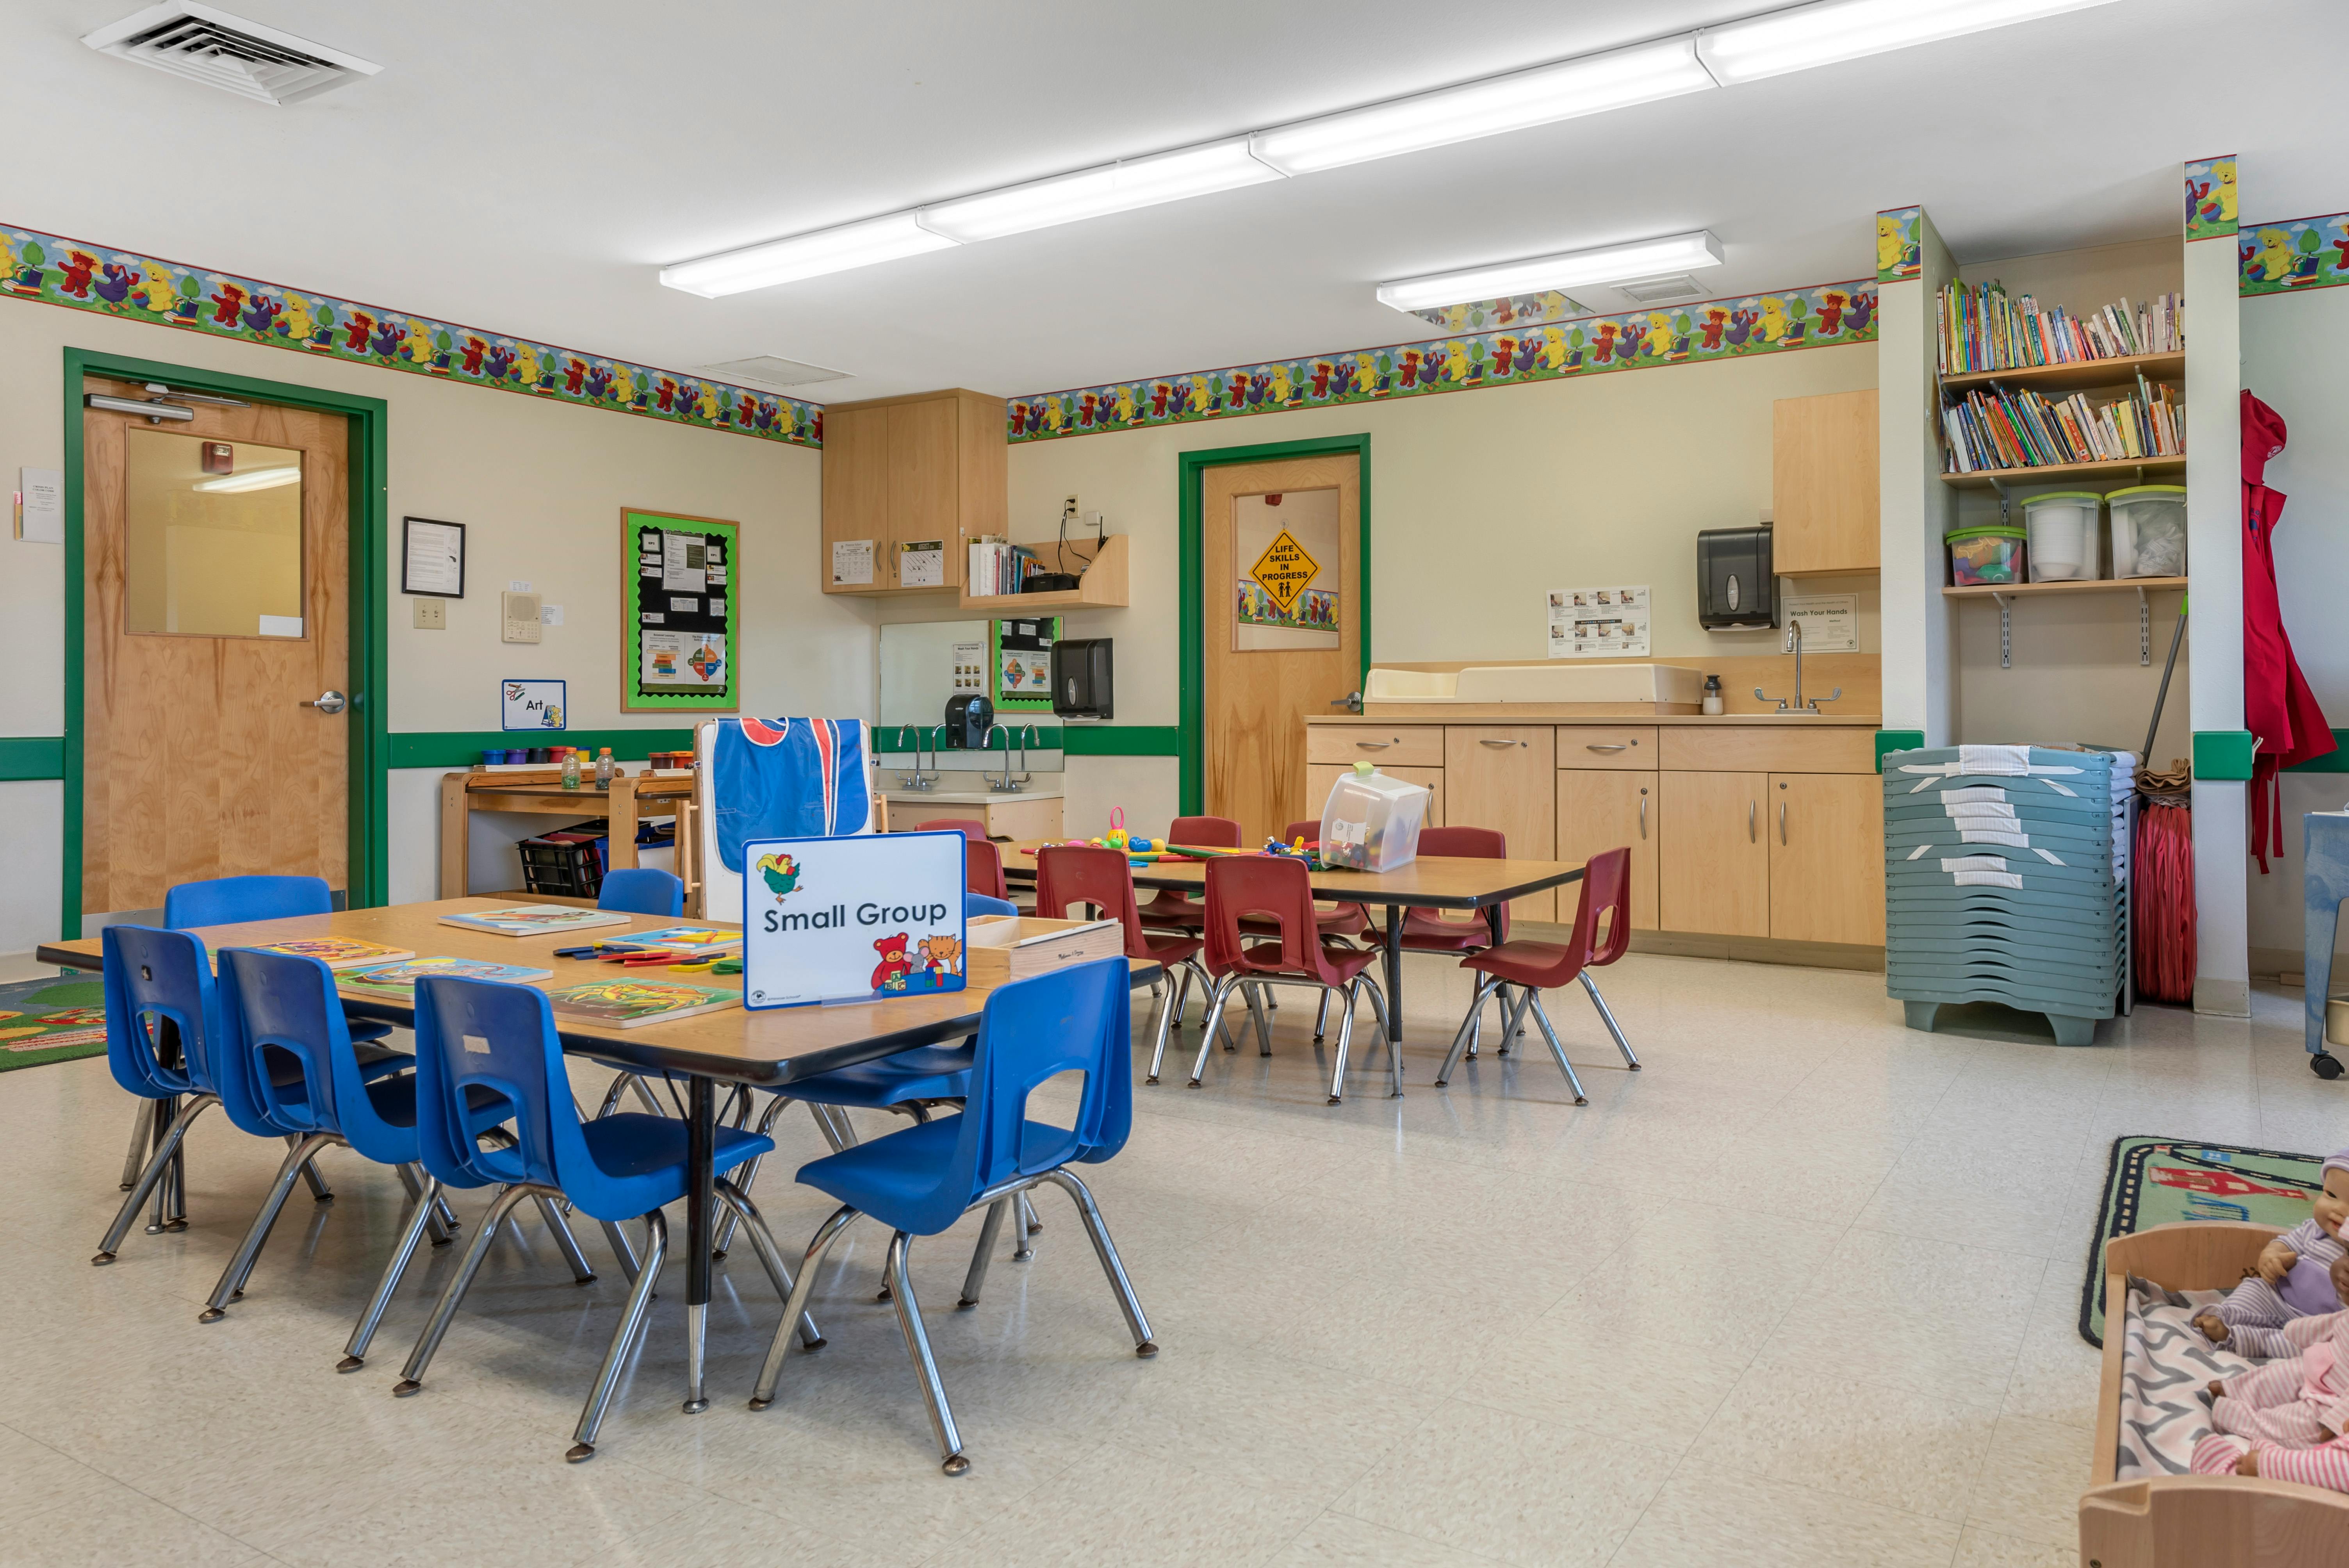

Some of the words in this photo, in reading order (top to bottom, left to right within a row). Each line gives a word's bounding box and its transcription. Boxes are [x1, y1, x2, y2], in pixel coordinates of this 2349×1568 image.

[1275, 545, 1294, 553] LIFE
[1269, 554, 1300, 562] SKILLS
[1262, 572, 1308, 581] PROGRESS
[526, 700, 543, 710] Art
[764, 904, 845, 933] Small
[857, 903, 947, 926] Group
